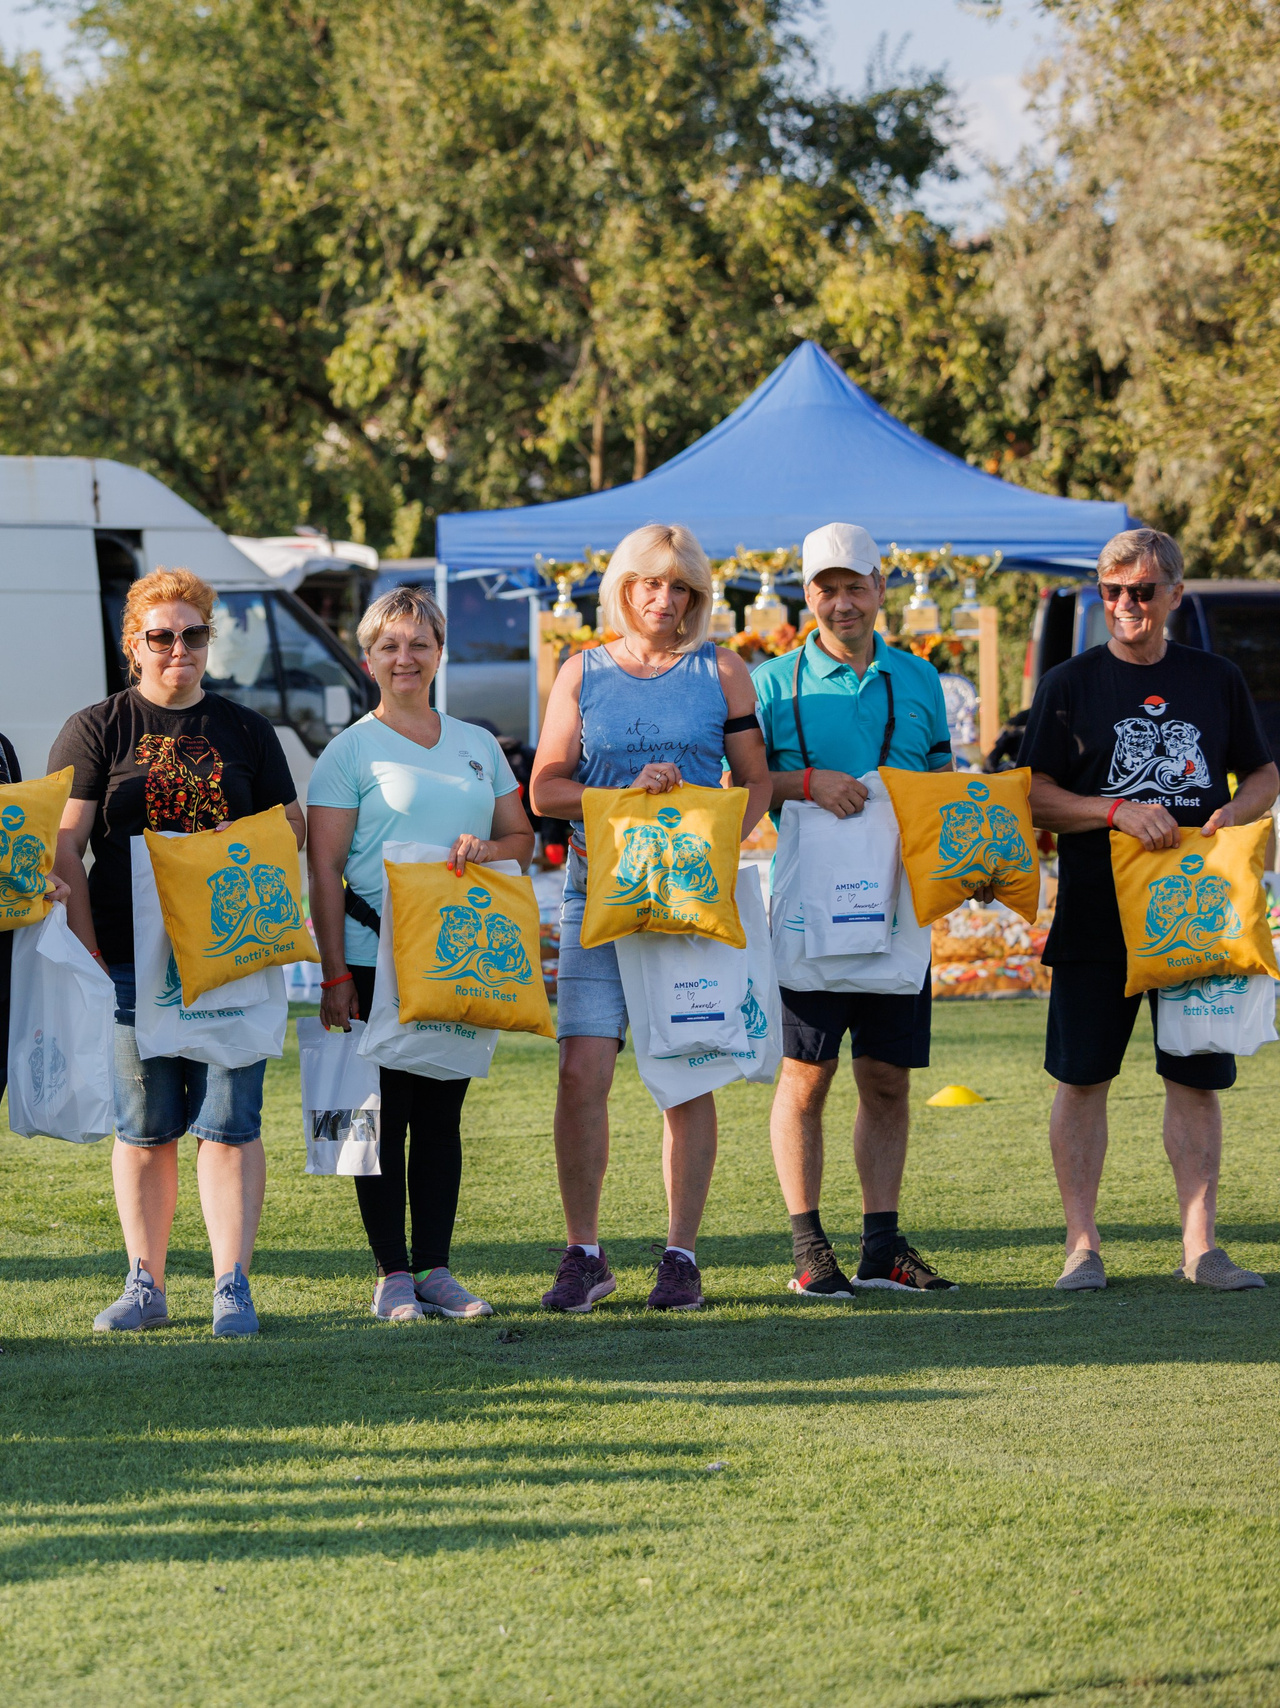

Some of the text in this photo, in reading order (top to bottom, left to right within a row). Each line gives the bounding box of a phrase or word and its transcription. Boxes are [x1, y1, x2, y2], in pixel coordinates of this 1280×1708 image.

[625, 717, 660, 736] it's
[627, 735, 698, 763] always
[1174, 795, 1201, 807] Rest
[6, 907, 31, 918] Rest
[673, 909, 700, 922] Rest
[234, 941, 296, 966] Rotti's Rest
[1166, 950, 1231, 968] Rotti's Rest
[455, 985, 518, 1003] Rotti's Rest
[179, 1009, 246, 1021] Rotti's Rest
[1183, 1004, 1235, 1016] Rotti's Rest
[454, 1024, 477, 1040] Rest
